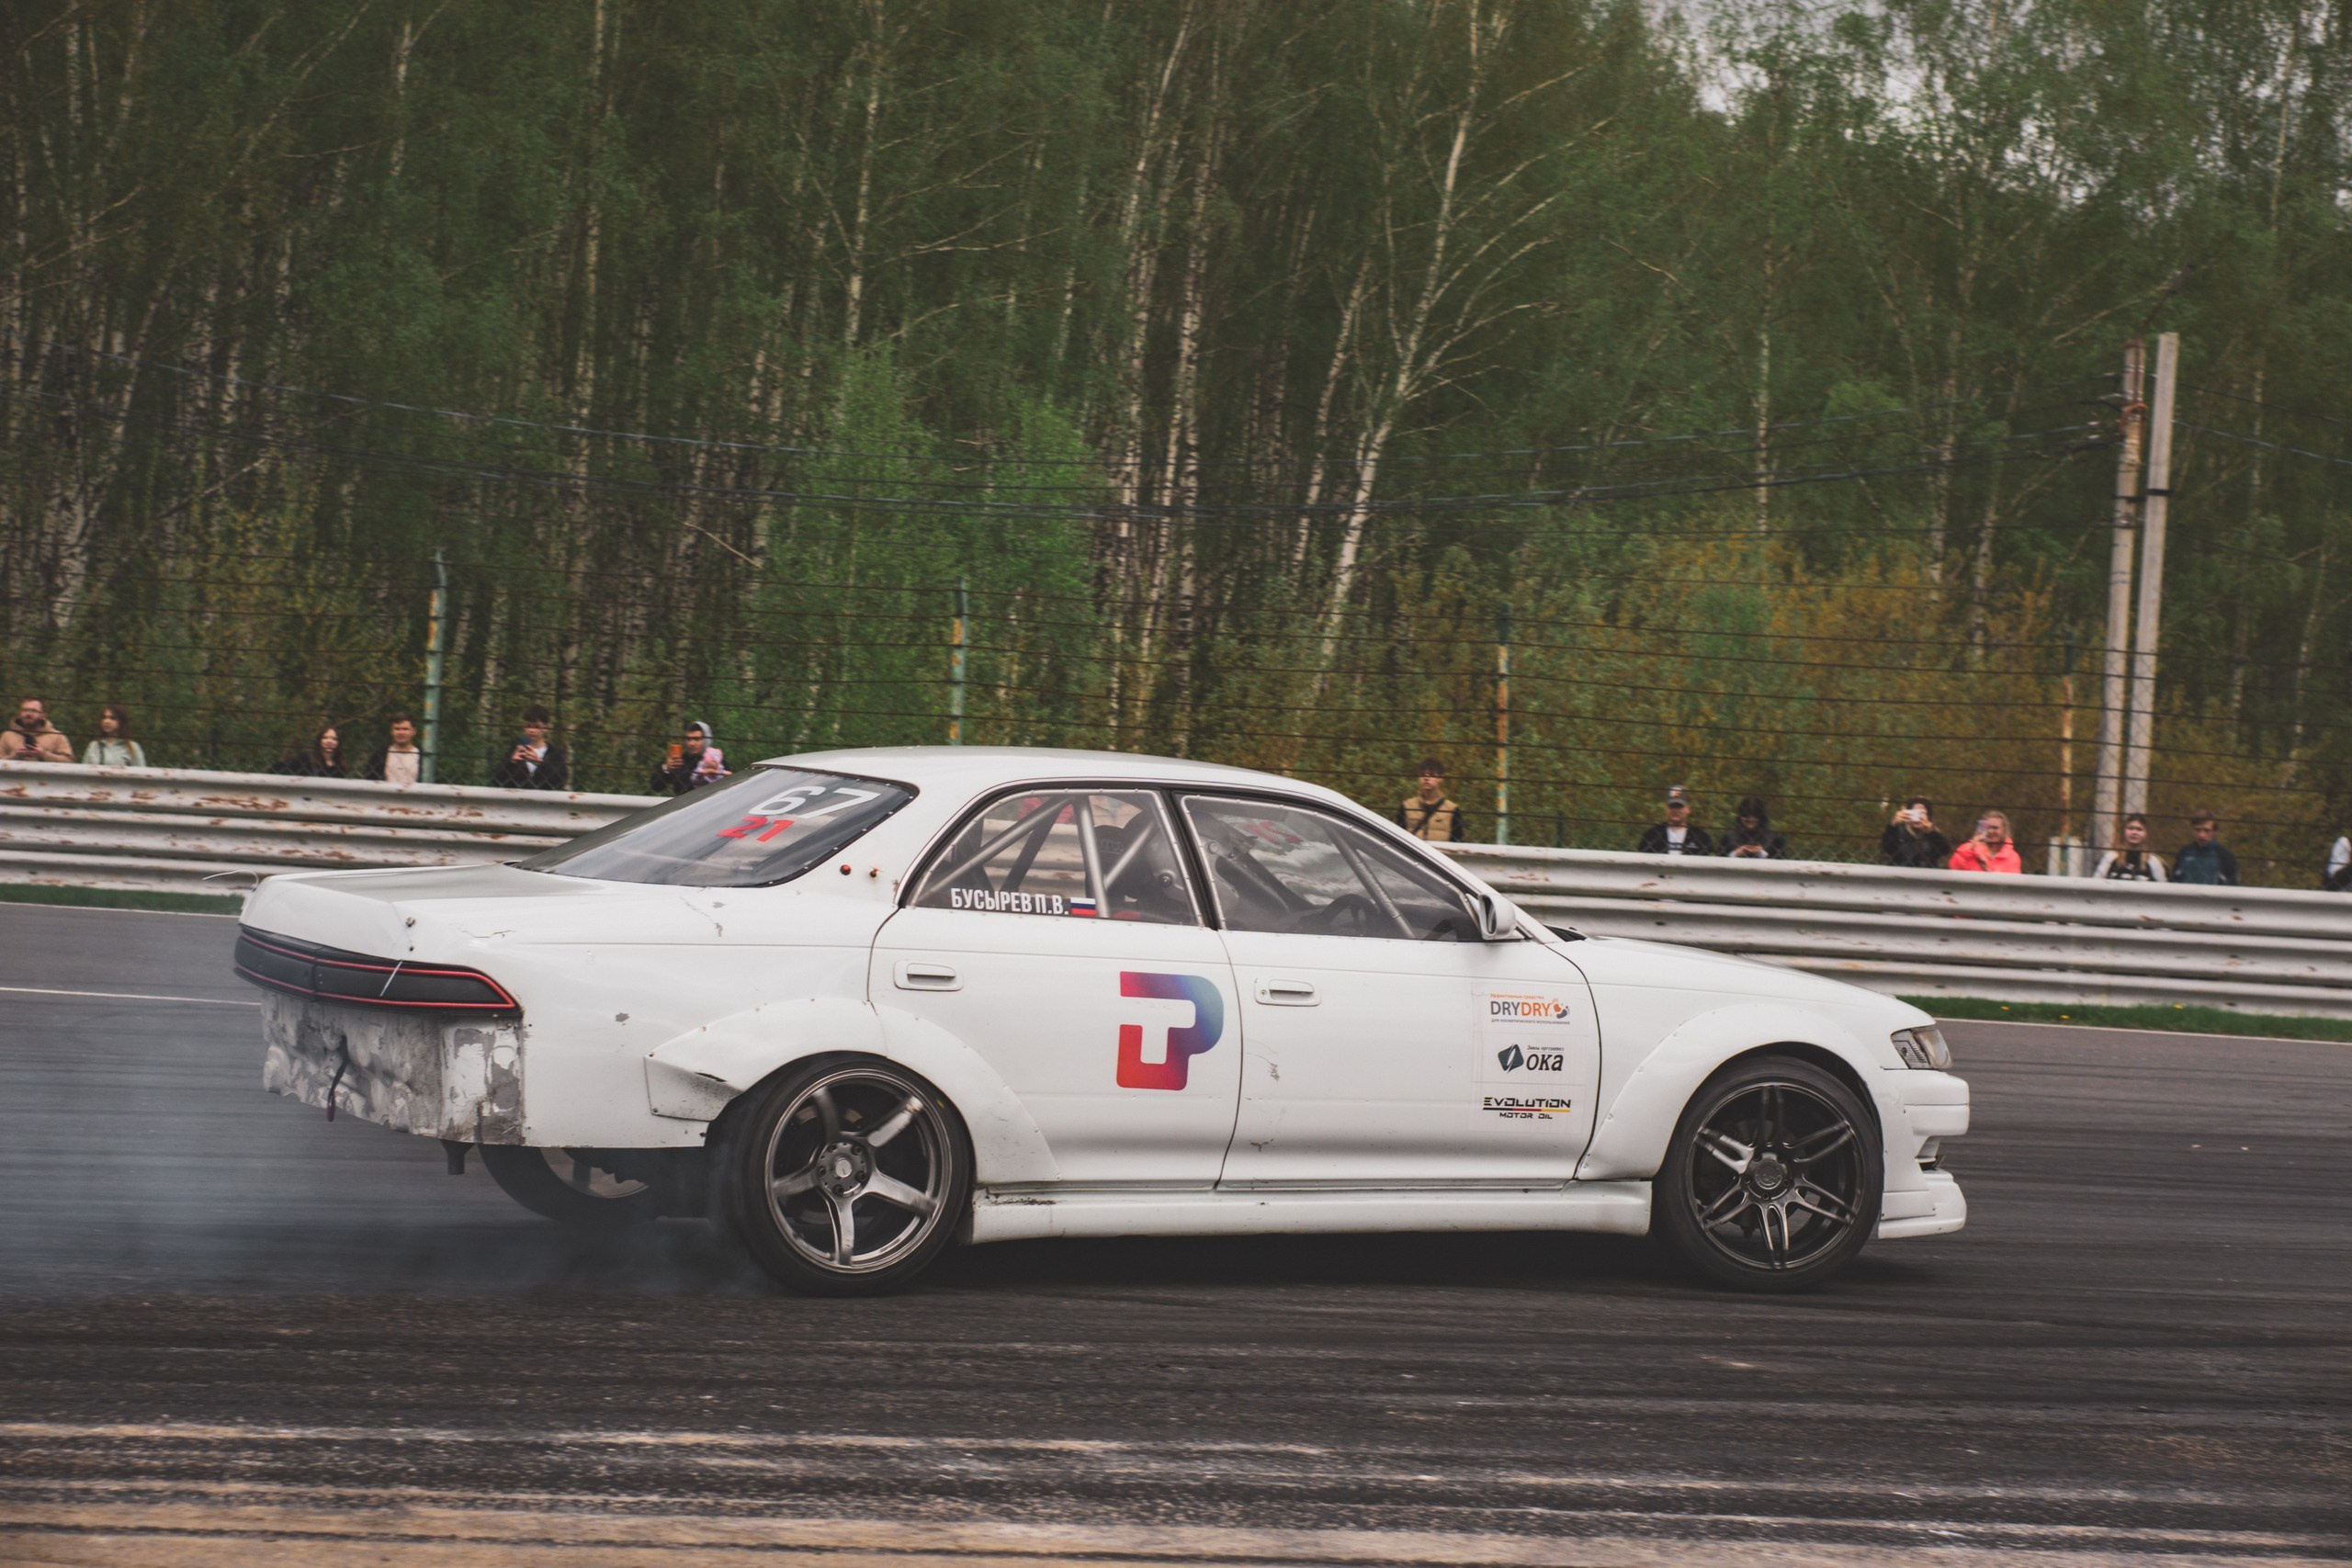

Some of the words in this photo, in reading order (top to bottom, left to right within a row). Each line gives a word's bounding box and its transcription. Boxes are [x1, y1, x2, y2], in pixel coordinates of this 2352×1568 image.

[748, 785, 882, 819] 67
[717, 816, 795, 842] 21
[950, 887, 1032, 913] БУСЫРЕВ
[1035, 893, 1069, 916] П.В.
[1490, 1000, 1551, 1017] DRYDRY
[1483, 1097, 1571, 1108] EVOLUTION
